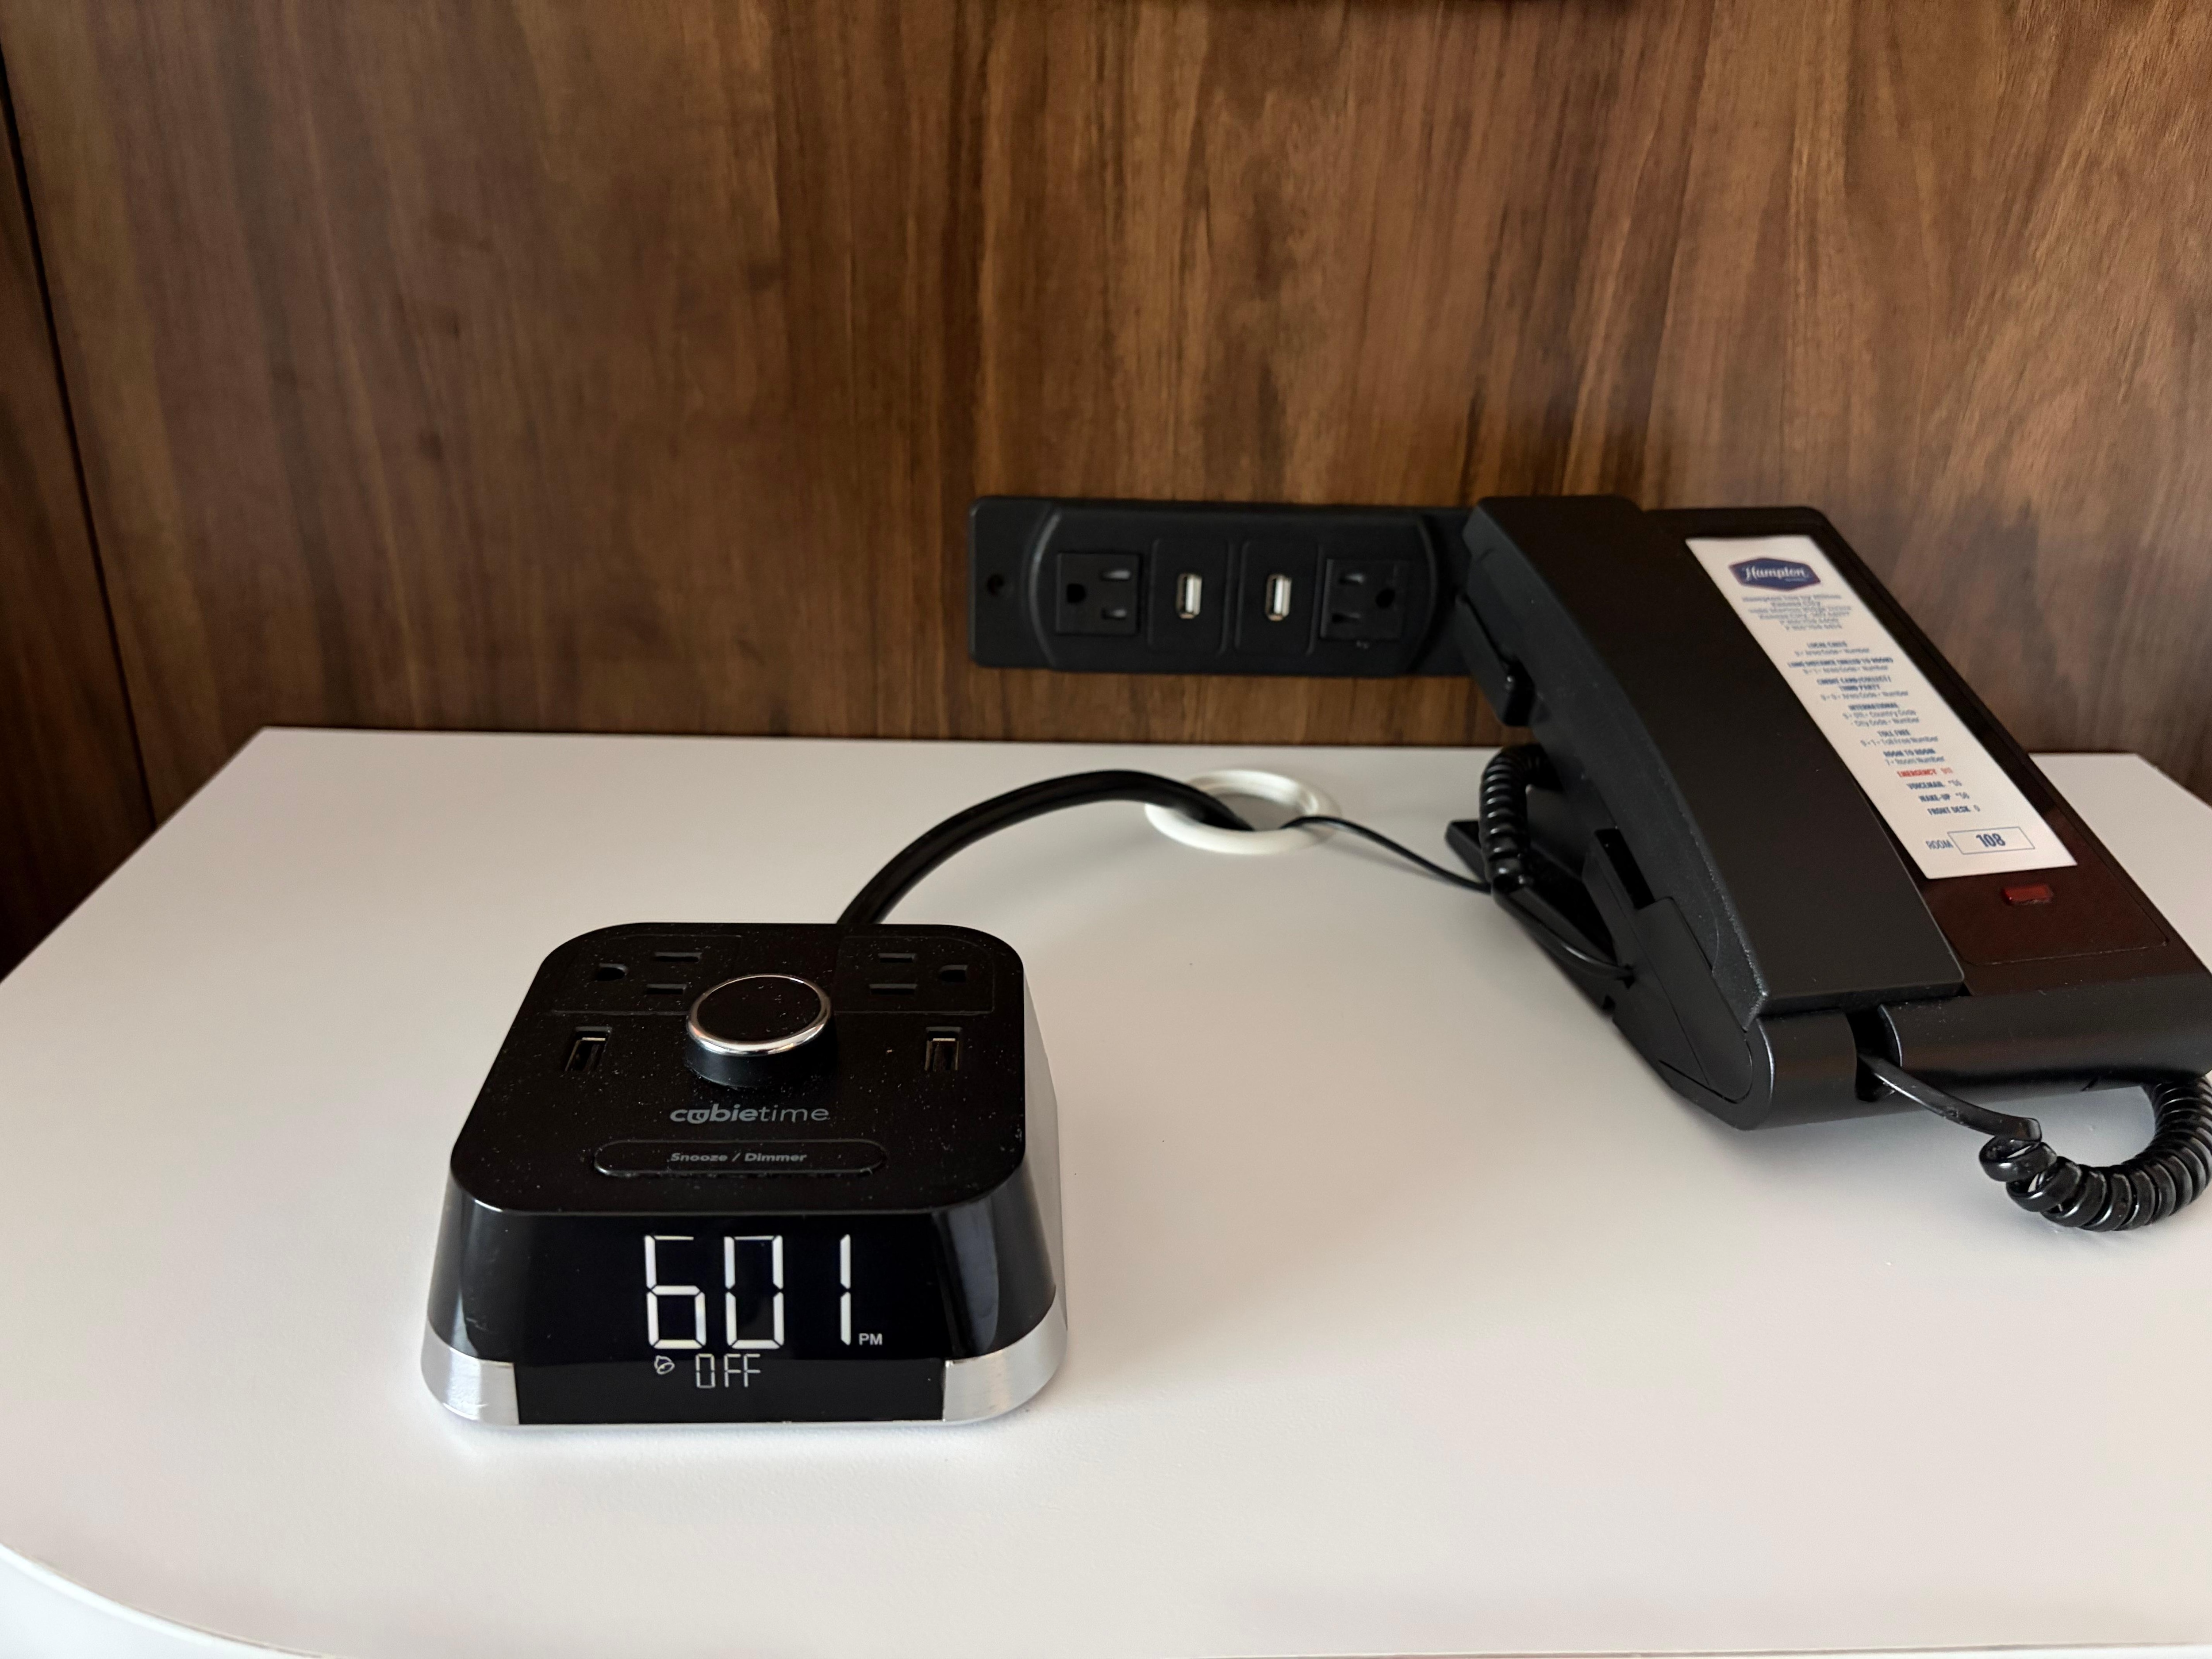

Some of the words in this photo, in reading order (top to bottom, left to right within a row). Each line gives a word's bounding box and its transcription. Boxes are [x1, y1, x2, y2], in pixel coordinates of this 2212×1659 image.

[1742, 565, 1809, 581] Hampton
[1897, 768, 1937, 777] EMERGENCY
[1906, 781, 1945, 790] VOICEMAIL
[1918, 793, 1951, 802] WAKE-UP
[1927, 806, 1951, 815] FRONT
[1925, 839, 1954, 850] ROOM
[1975, 833, 2006, 848] 108
[670, 1103, 829, 1124] cubietime
[670, 1152, 728, 1162] Snooze
[744, 1152, 807, 1162] Dimmer
[858, 1333, 883, 1346] PM
[695, 1353, 761, 1389] OFF
